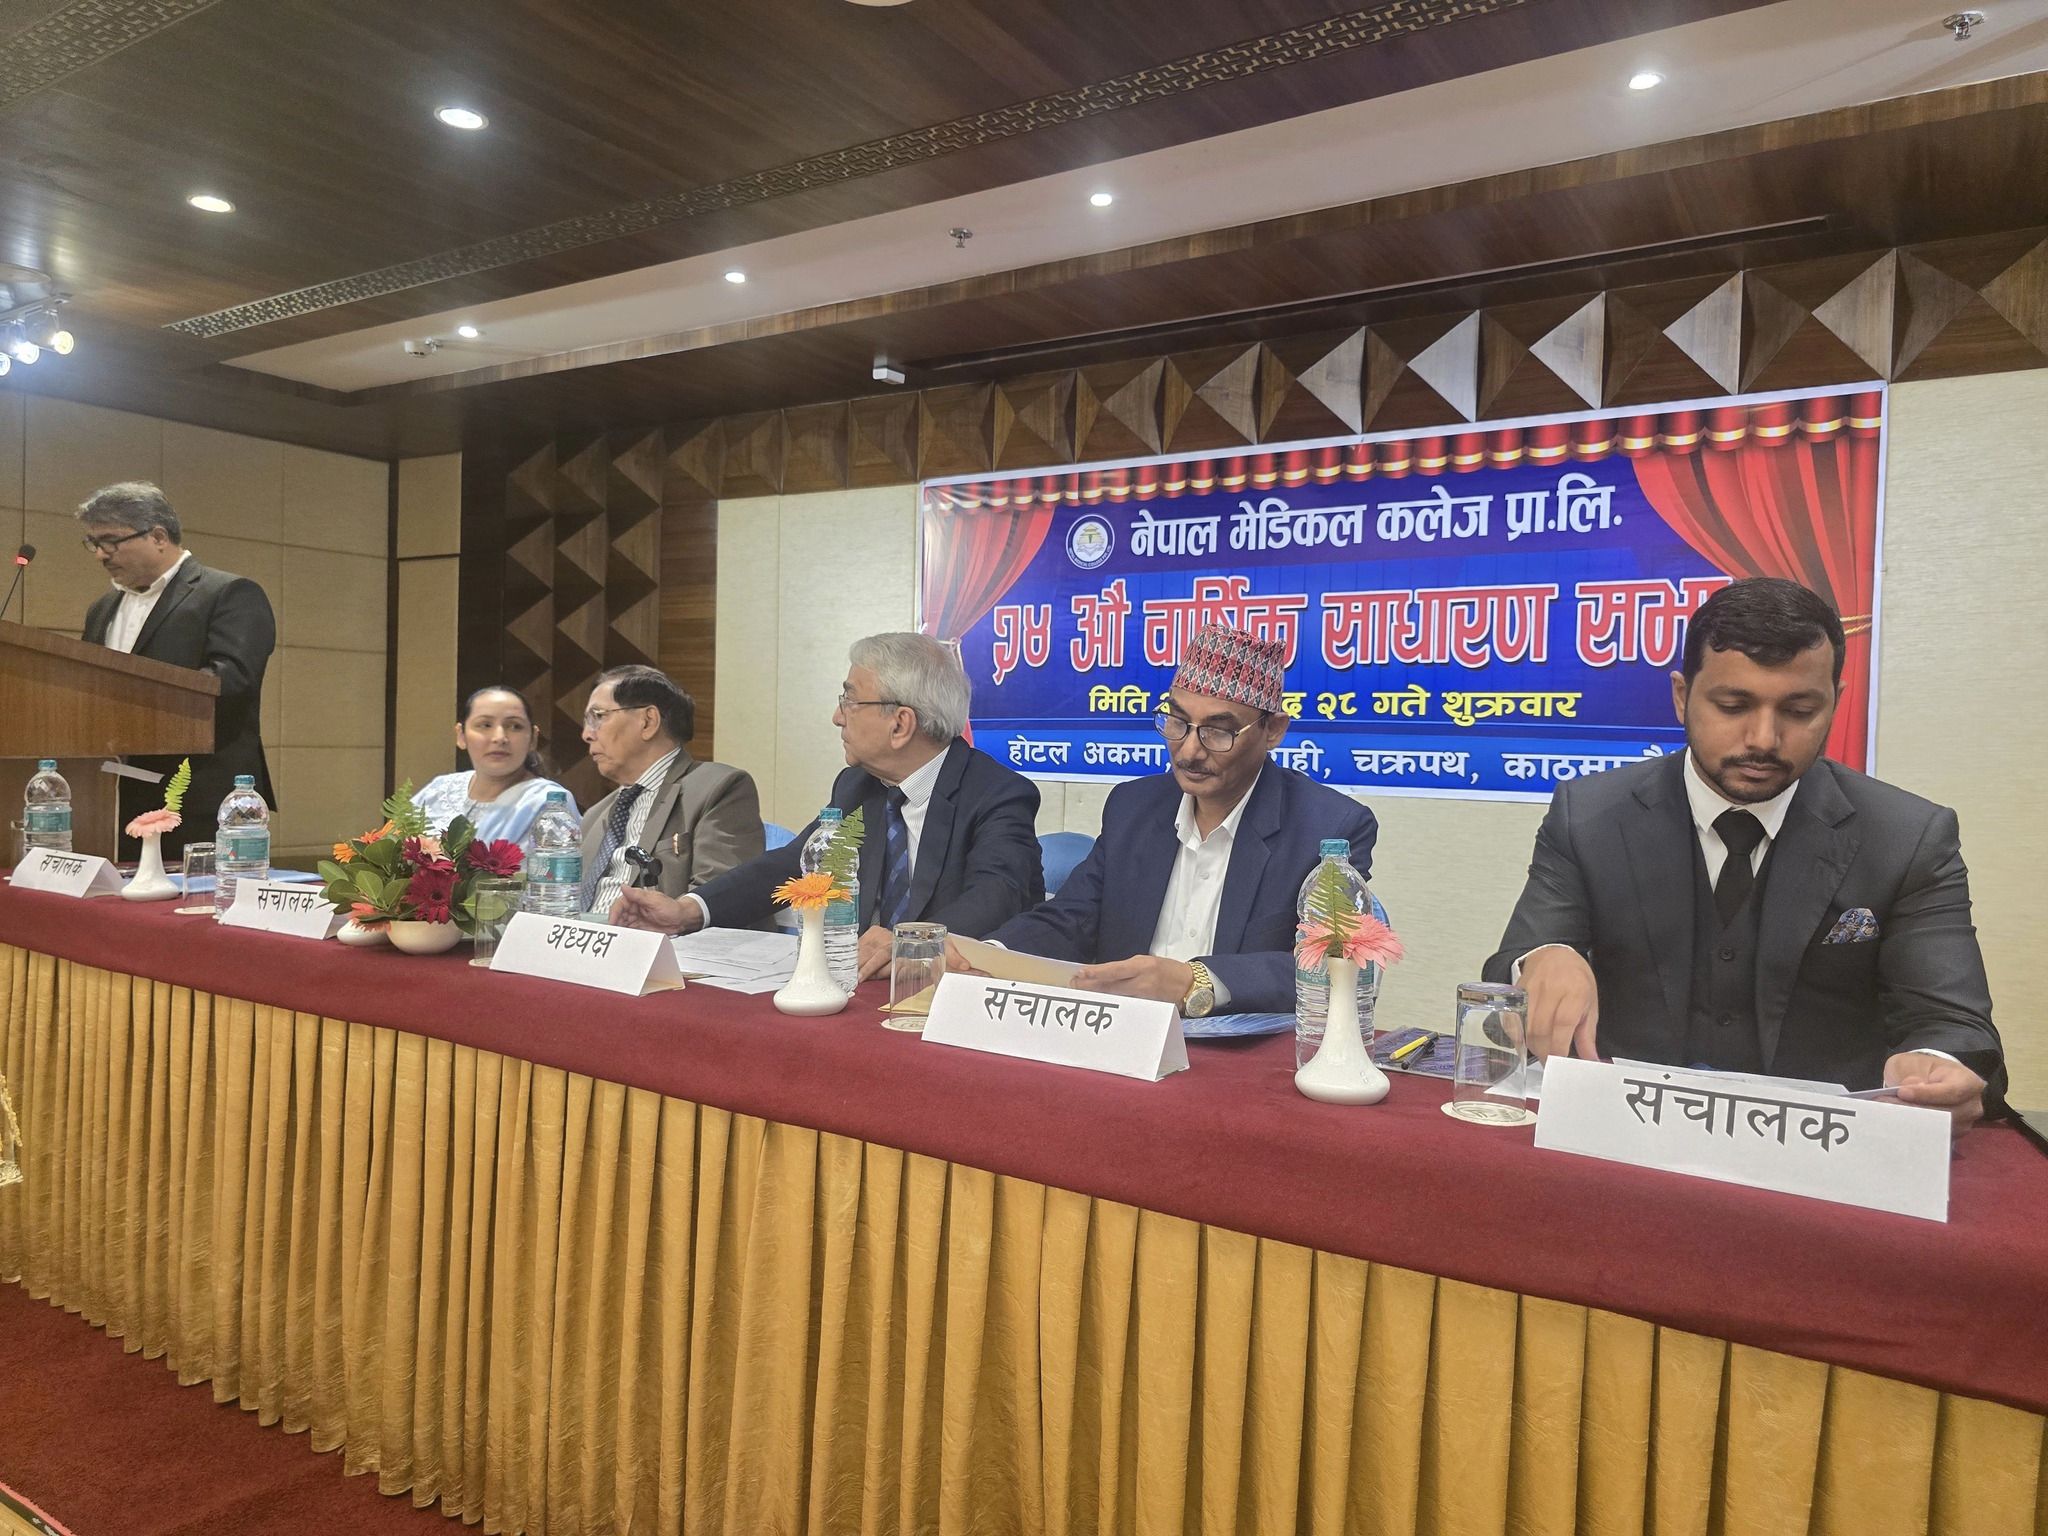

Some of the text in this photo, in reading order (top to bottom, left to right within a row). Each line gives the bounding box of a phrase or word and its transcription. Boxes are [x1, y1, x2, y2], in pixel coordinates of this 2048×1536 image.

[1131, 509, 1221, 557] नेपाल
[1229, 497, 1367, 551] मेडिकल
[1376, 484, 1493, 542] कलेज
[1505, 472, 1623, 541] प्रा.लि.
[1321, 583, 1559, 669] साधारण
[1575, 576, 1734, 667] सभ
[1089, 685, 1151, 714] मिति
[1316, 691, 1357, 721] २८
[1372, 684, 1431, 718] गते
[1441, 691, 1583, 726] शुक्रवार
[1008, 734, 1072, 766] होटल
[1352, 749, 1479, 785] चक्रपथ,
[258, 883, 318, 912] संचालक
[547, 924, 618, 958] अध्यक्ष
[984, 982, 1120, 1035] संचालक
[1623, 1073, 1857, 1152] संचालक
